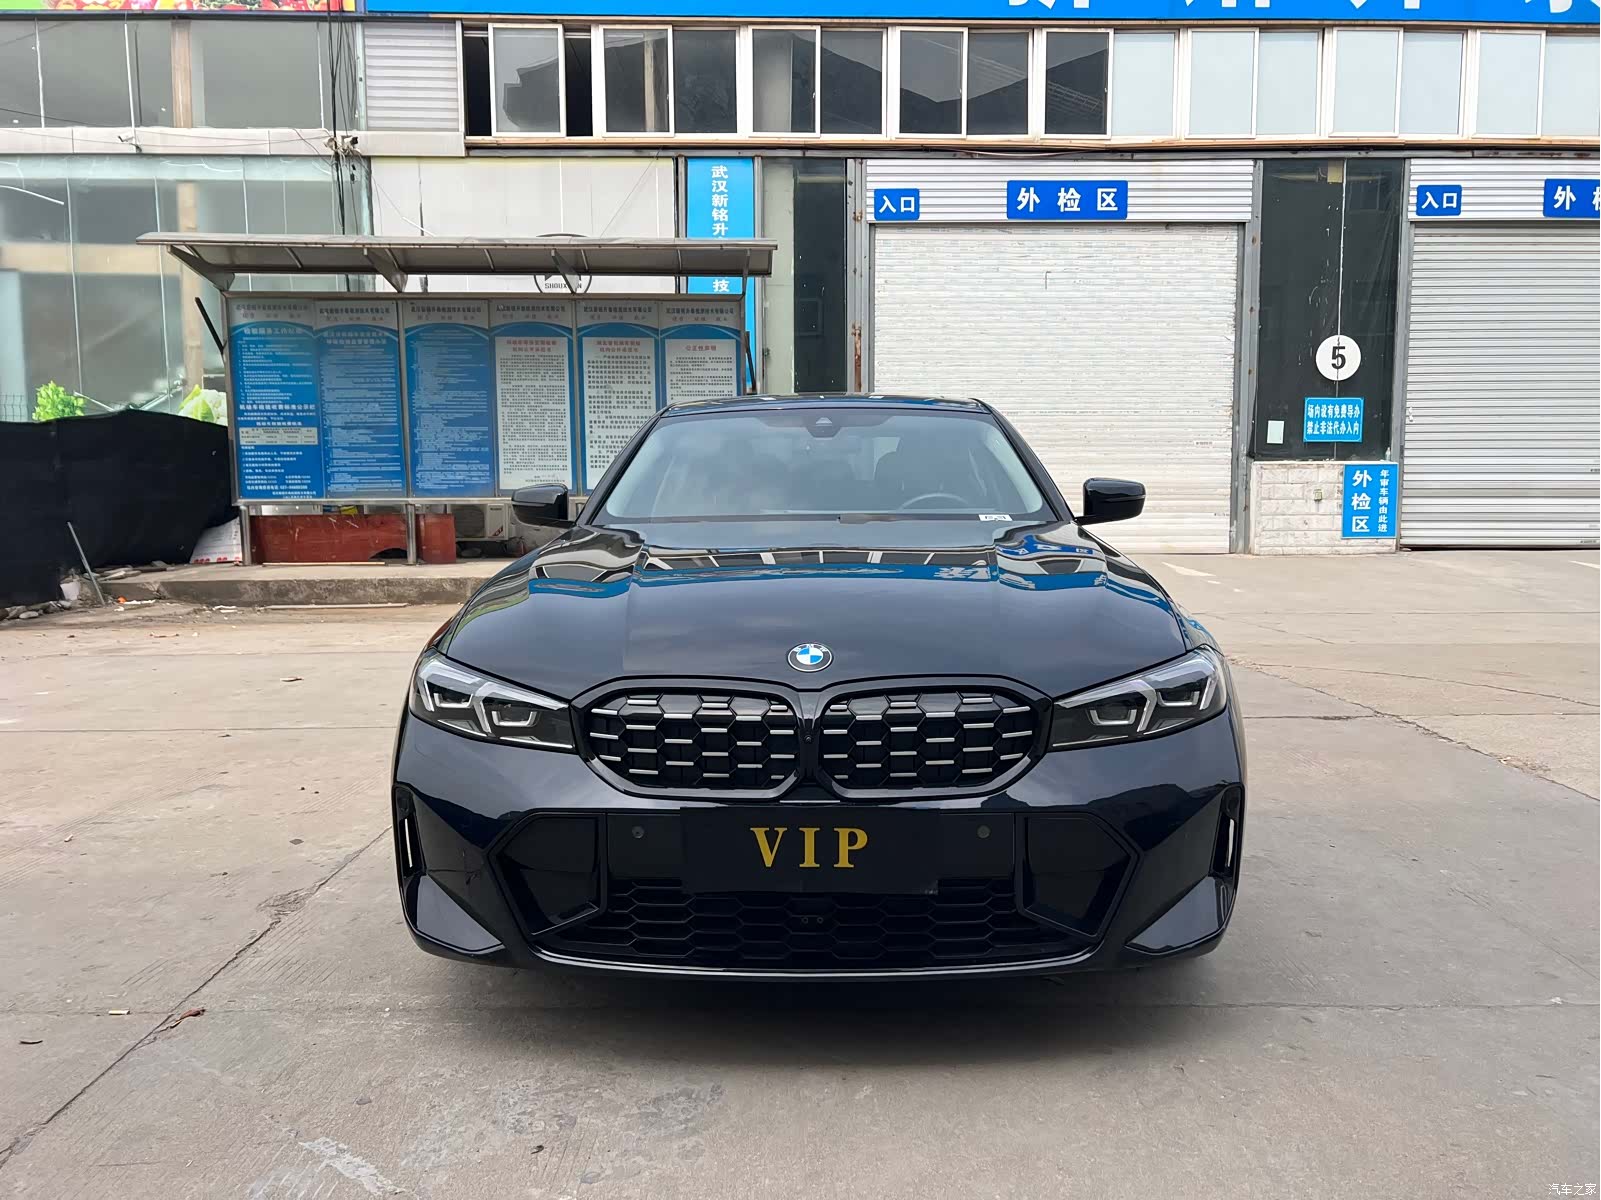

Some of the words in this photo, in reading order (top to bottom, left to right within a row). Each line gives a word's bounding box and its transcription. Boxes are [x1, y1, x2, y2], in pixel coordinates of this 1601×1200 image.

[879, 195, 915, 213] 入口
[1017, 187, 1118, 212] 外检区
[1421, 191, 1458, 209] 入口
[1331, 345, 1346, 370] 5
[1307, 403, 1361, 419] 场内设有免费导办
[1306, 421, 1360, 436] 禁止非法代办入内
[1351, 469, 1373, 533] 外检区
[1378, 469, 1390, 533] 年审车辆由此进
[750, 827, 868, 868] VIP
